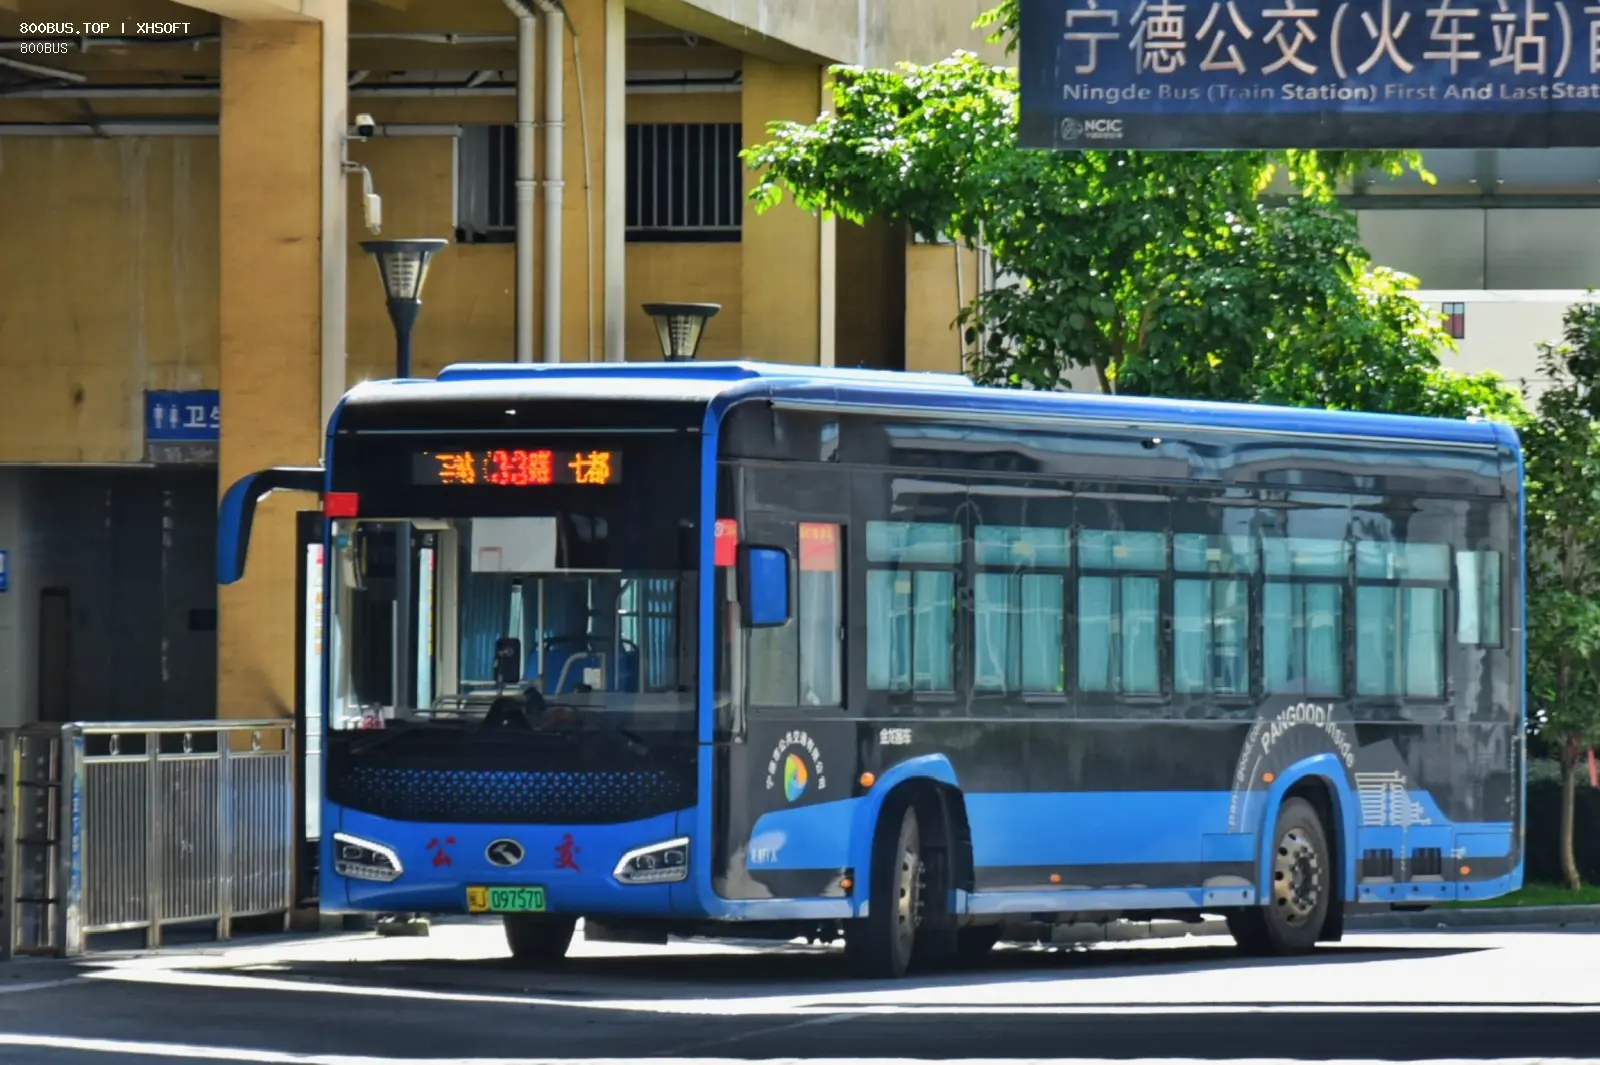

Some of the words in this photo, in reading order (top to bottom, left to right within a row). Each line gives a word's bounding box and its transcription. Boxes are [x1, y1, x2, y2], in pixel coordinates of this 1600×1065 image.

[1063, 0, 1600, 78] 宁德公交(火车站)
[1063, 83, 1151, 104] Ningde
[1158, 84, 1200, 100] Bus
[1207, 84, 1275, 102] (Train
[1281, 83, 1378, 102] Station)
[1384, 83, 1436, 100] First
[1444, 83, 1493, 100] And
[1501, 83, 1549, 100] Last
[1084, 119, 1123, 132] NCIC
